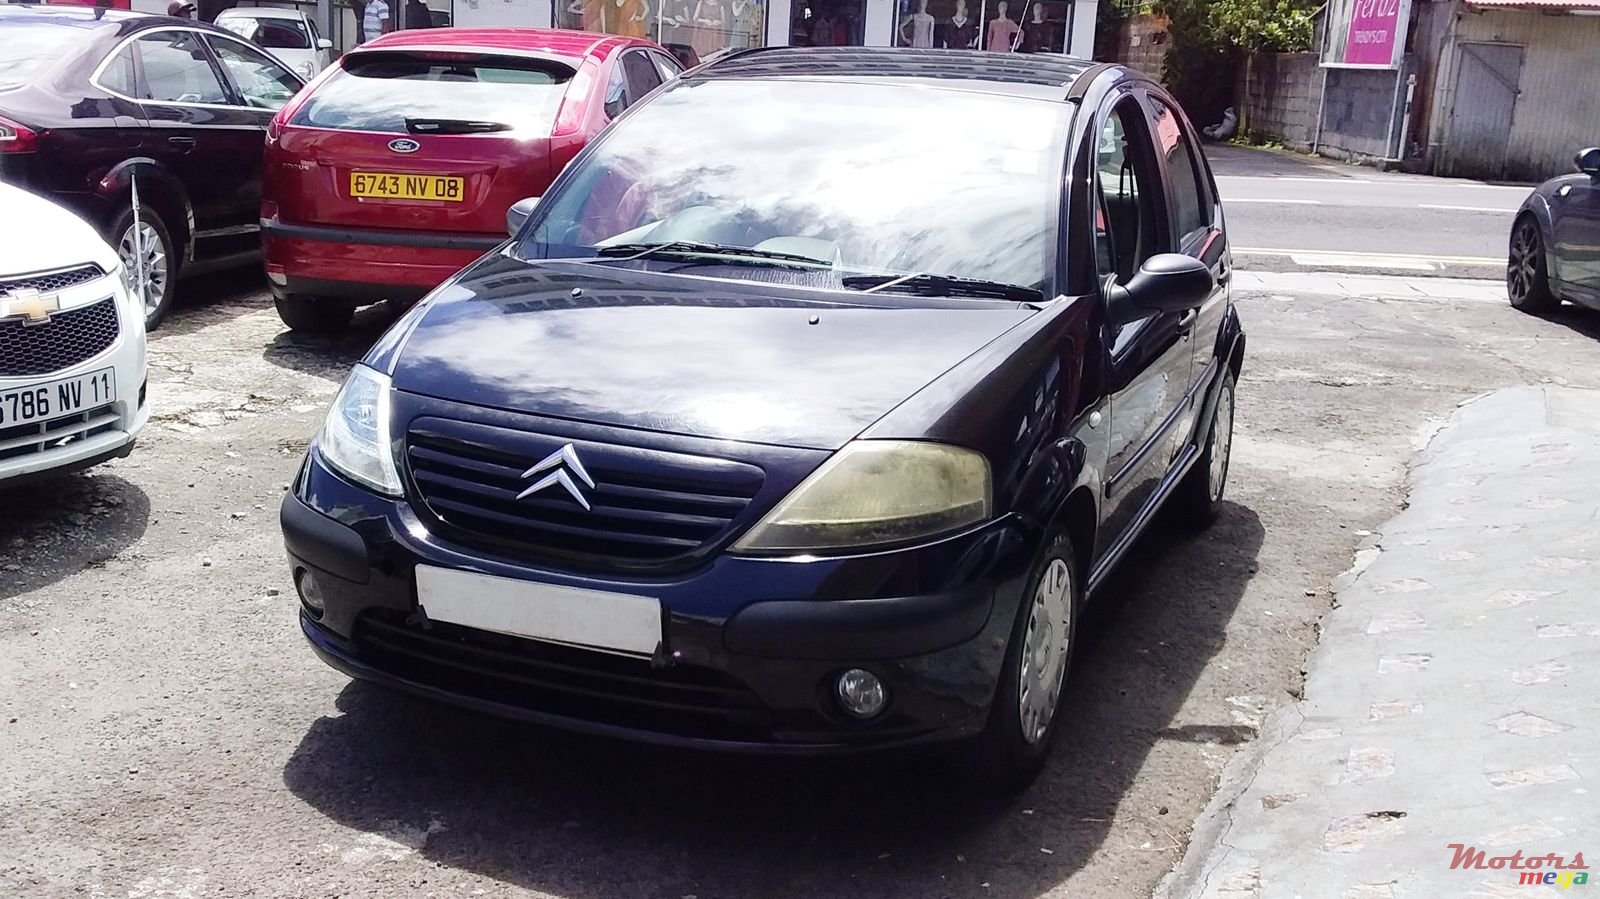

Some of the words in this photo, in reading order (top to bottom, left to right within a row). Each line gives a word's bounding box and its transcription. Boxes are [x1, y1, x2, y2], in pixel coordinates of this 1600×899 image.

[355, 175, 399, 194] 6743
[406, 177, 429, 195] NV
[435, 179, 459, 197] 08
[0, 388, 49, 424] 786
[58, 380, 81, 411] NV
[91, 373, 109, 402] 11
